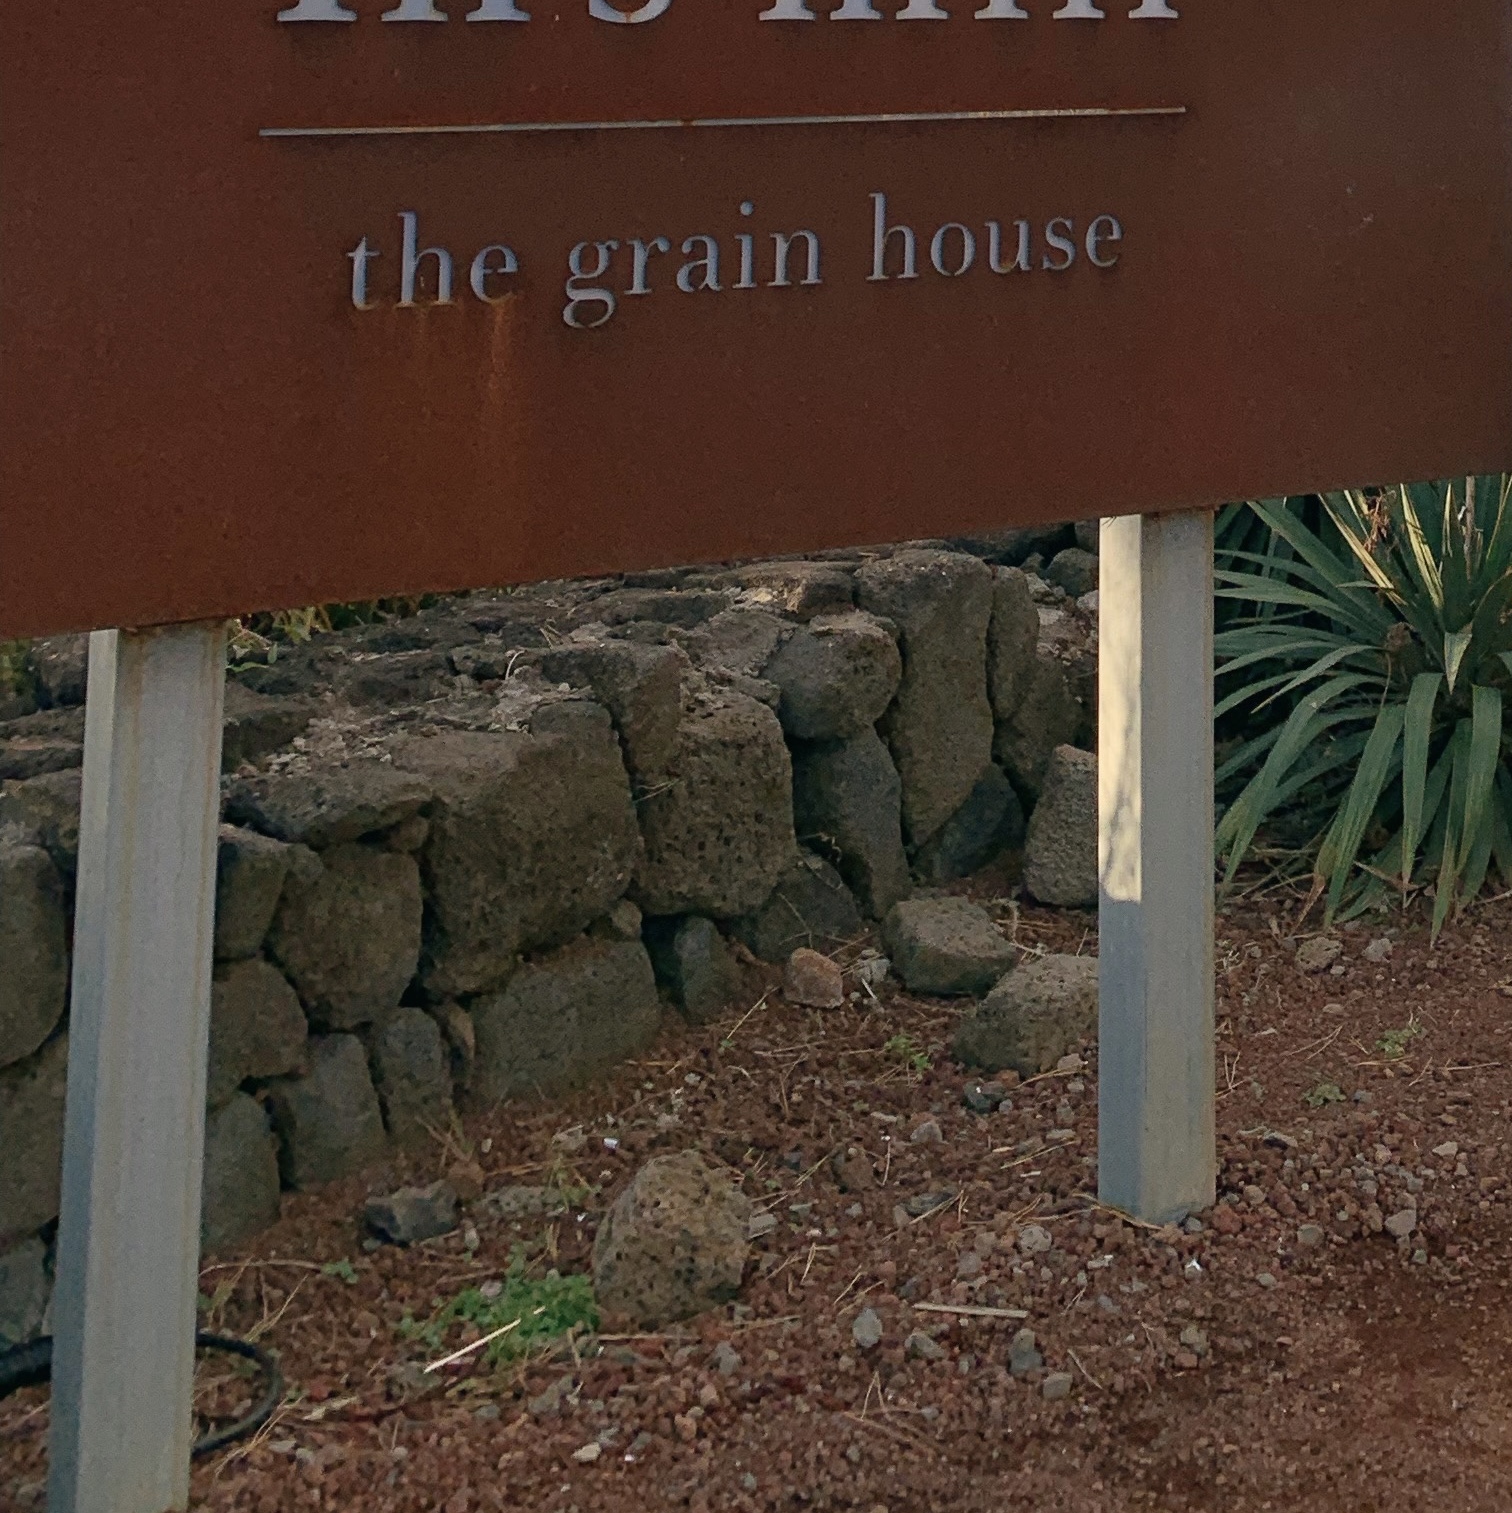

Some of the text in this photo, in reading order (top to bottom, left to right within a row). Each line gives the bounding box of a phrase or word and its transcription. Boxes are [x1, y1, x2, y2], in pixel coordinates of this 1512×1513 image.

[346, 192, 1125, 330] the grain house
